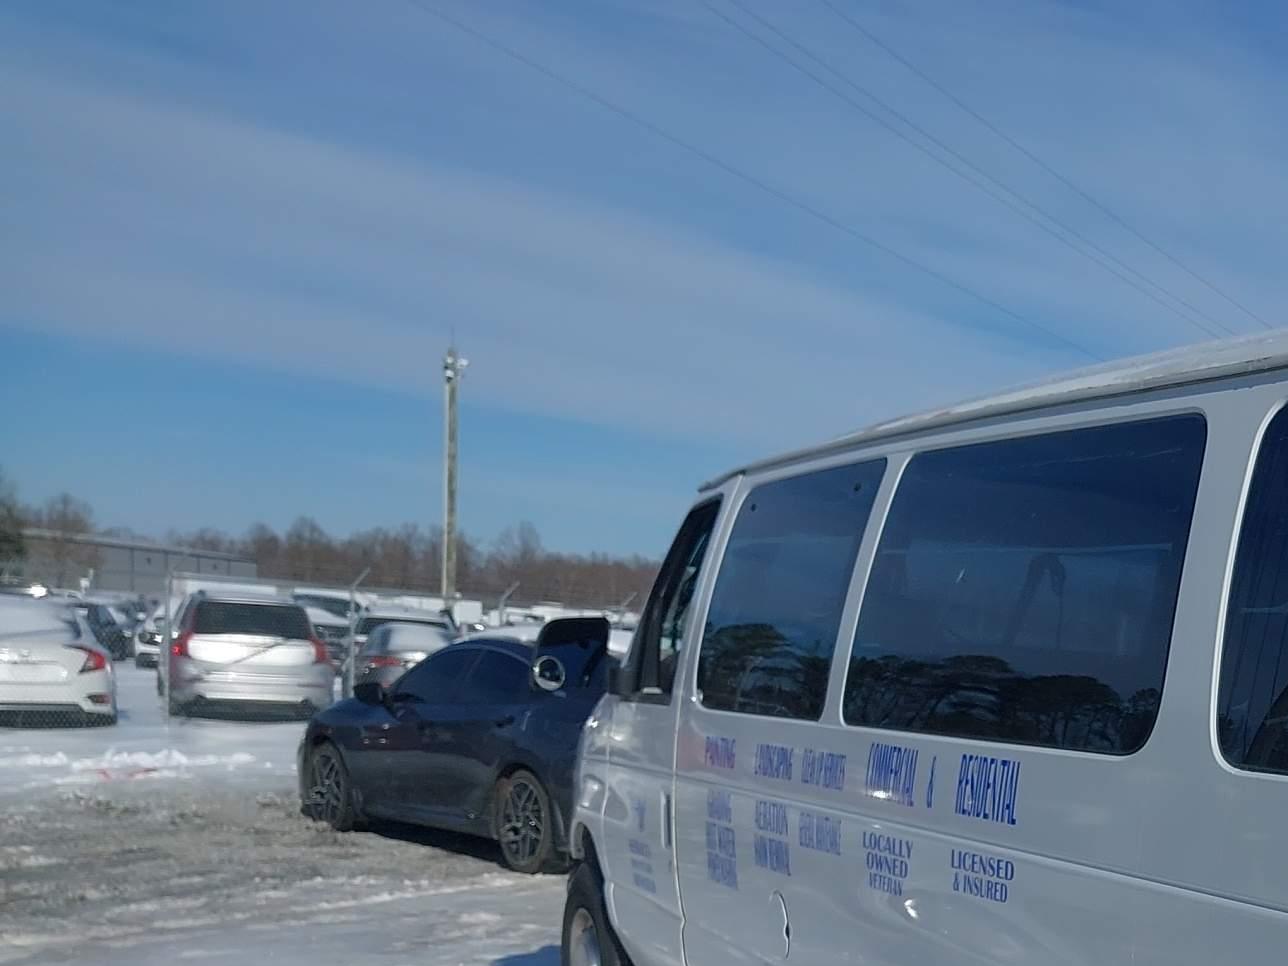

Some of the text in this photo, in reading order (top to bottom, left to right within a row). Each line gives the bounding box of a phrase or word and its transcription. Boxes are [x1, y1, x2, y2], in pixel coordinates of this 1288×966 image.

[865, 742, 1021, 825] COMMERCIAL & RESIDENTIAL
[862, 831, 914, 859] LOCALLY
[866, 852, 908, 878] OWNED
[951, 849, 1015, 881] LICENSED
[868, 872, 903, 896] VETERAN
[952, 873, 1008, 903] & INSURED
